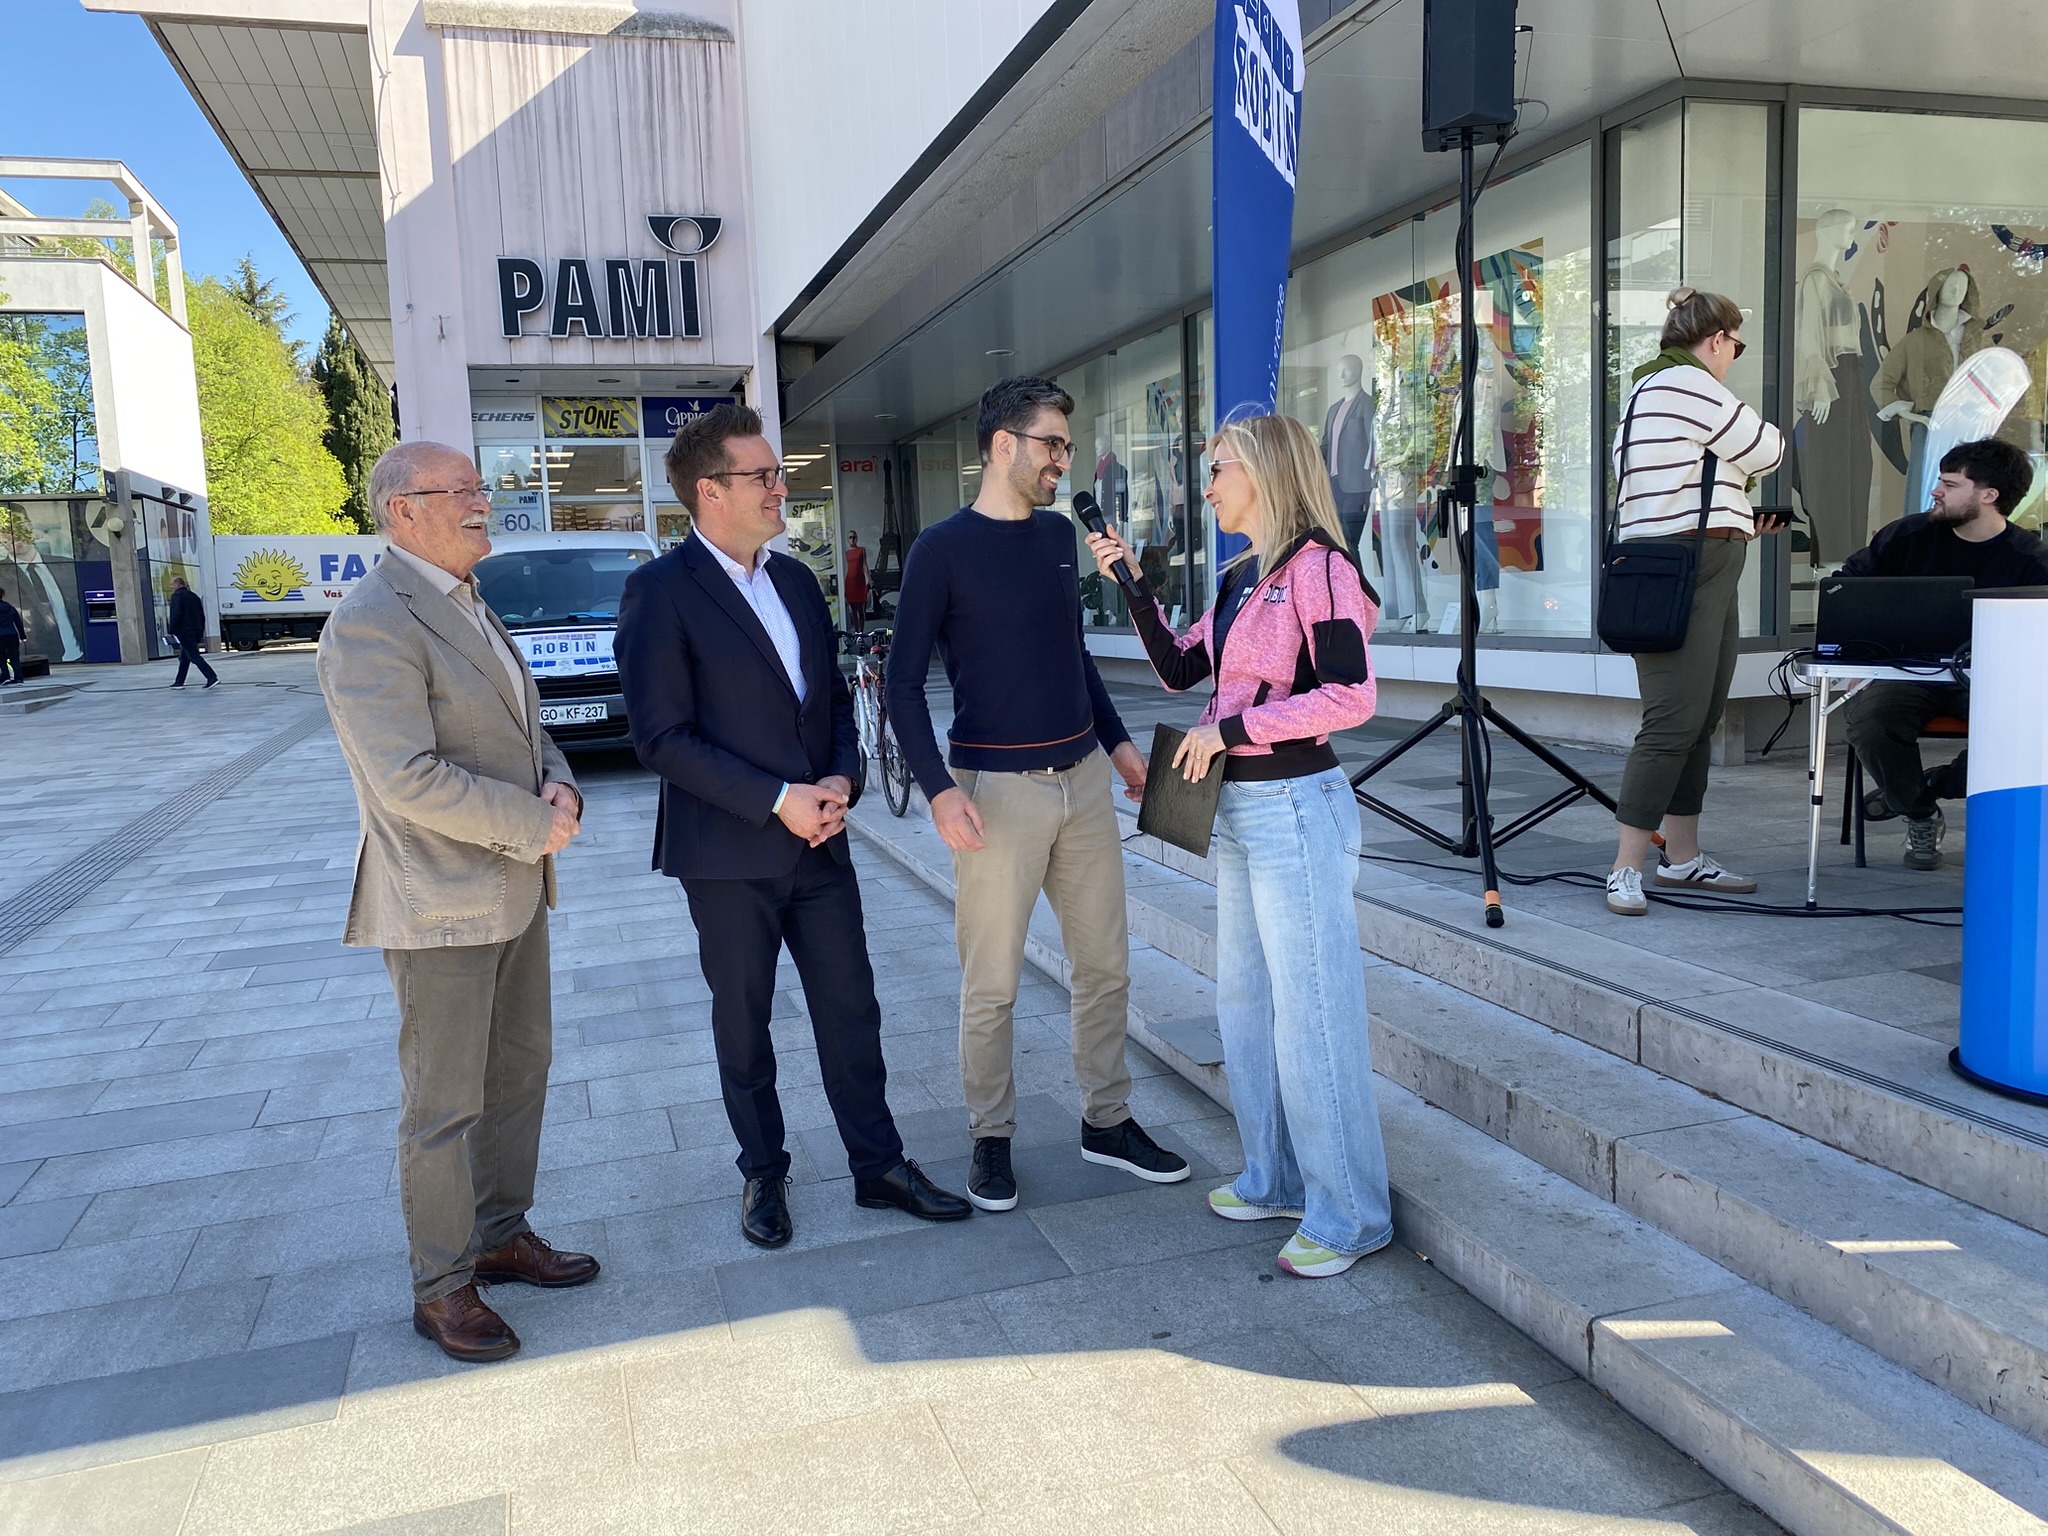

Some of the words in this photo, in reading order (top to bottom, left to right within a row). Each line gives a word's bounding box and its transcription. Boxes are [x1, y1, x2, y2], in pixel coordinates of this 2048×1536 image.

[1234, 32, 1296, 176] ROBIN
[496, 255, 702, 338] PAMI
[559, 405, 620, 430] STONE
[840, 458, 873, 473] ara
[518, 495, 538, 504] PAMI
[319, 554, 381, 581] FA
[323, 589, 343, 598] Vaš
[533, 641, 596, 655] ROBIN
[540, 709, 558, 720] GO
[566, 706, 604, 719] KF-237
